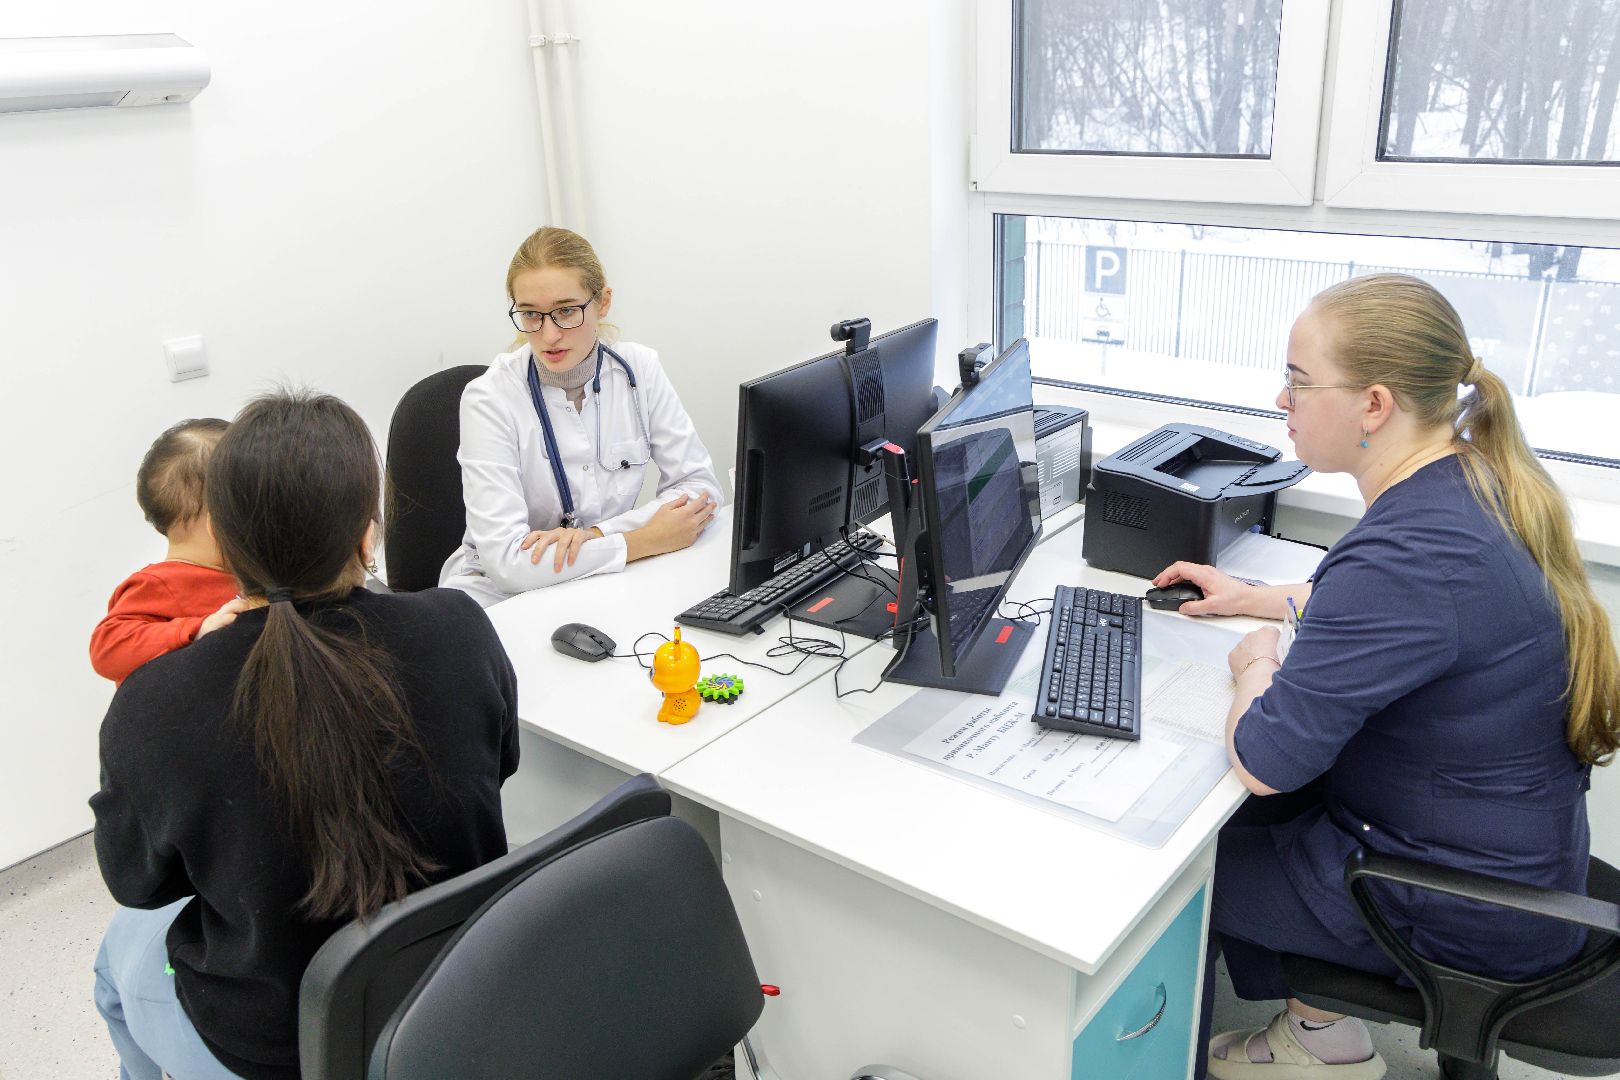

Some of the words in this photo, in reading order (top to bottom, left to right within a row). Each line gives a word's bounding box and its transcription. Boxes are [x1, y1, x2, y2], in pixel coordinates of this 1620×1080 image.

[1095, 249, 1120, 289] P
[941, 726, 968, 744] Режим
[966, 707, 992, 728] работы
[989, 701, 1020, 725] кабинета
